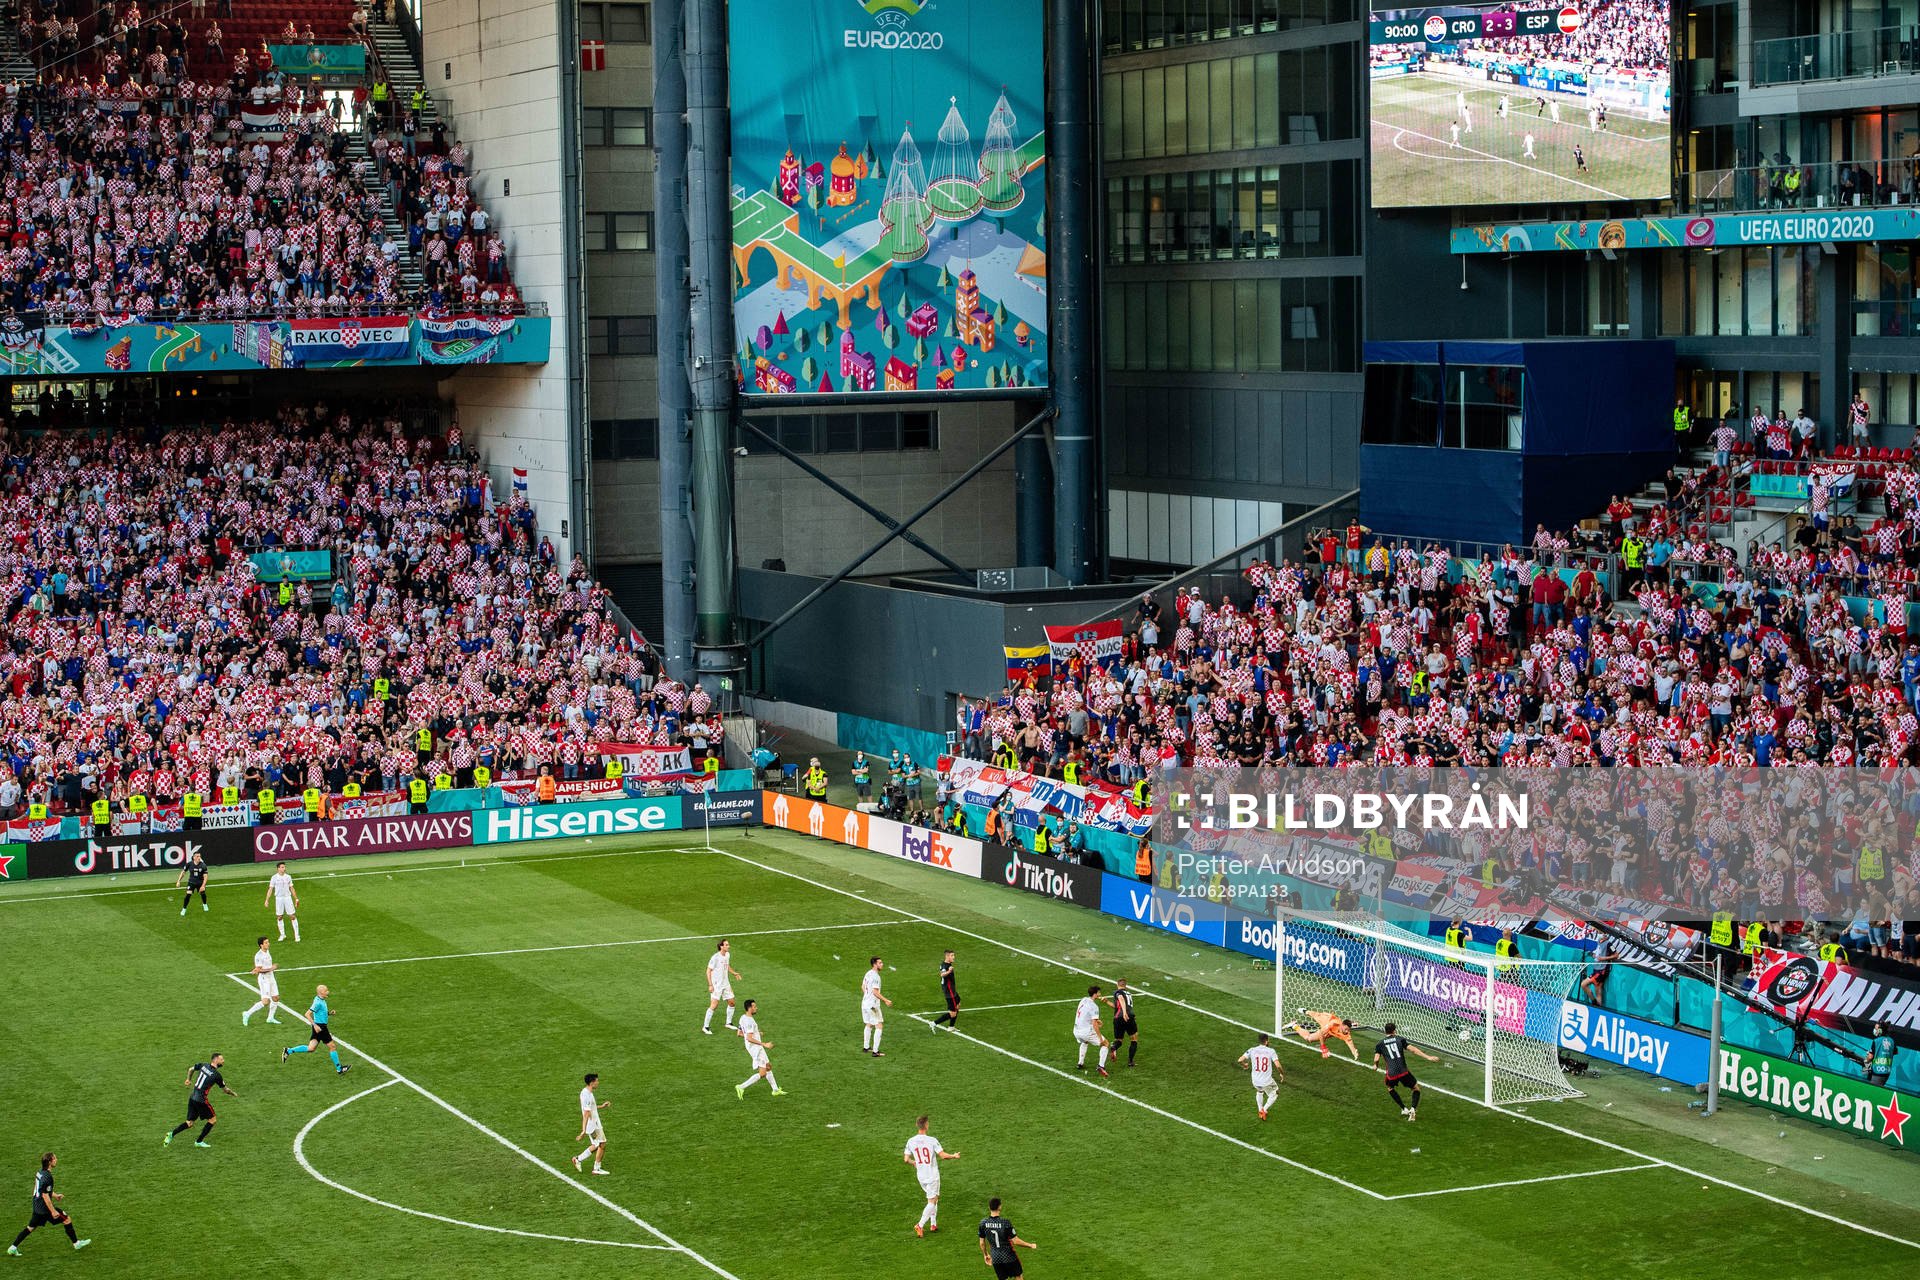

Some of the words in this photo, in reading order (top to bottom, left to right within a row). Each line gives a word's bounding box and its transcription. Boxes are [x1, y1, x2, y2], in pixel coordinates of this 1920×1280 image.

[876, 13, 907, 27] UEFA
[1385, 25, 1418, 38] 90:00
[1452, 20, 1476, 34] CRO
[1485, 20, 1494, 32] 2
[1504, 18, 1513, 30] 3
[1526, 16, 1550, 29] ESP
[844, 30, 943, 49] EURO2020
[1740, 219, 1782, 241] UEFA
[1784, 218, 1829, 240] EURO
[1831, 215, 1874, 238] 2020
[201, 816, 246, 829] RVATSKA
[256, 826, 349, 855] QATAR
[357, 816, 472, 846] AIRWAYS
[488, 806, 665, 842] Hisense
[106, 840, 203, 869] TikTok
[902, 825, 953, 869] FedEx
[1022, 862, 1074, 900] TikTok
[1130, 887, 1195, 934] vivo
[1812, 970, 1881, 1019] MI
[1592, 1015, 1670, 1075] Alipay
[1255, 1056, 1268, 1073] 18
[1719, 1050, 1875, 1132] Heineken
[914, 1147, 931, 1165] 19
[991, 1230, 1000, 1248] 7
